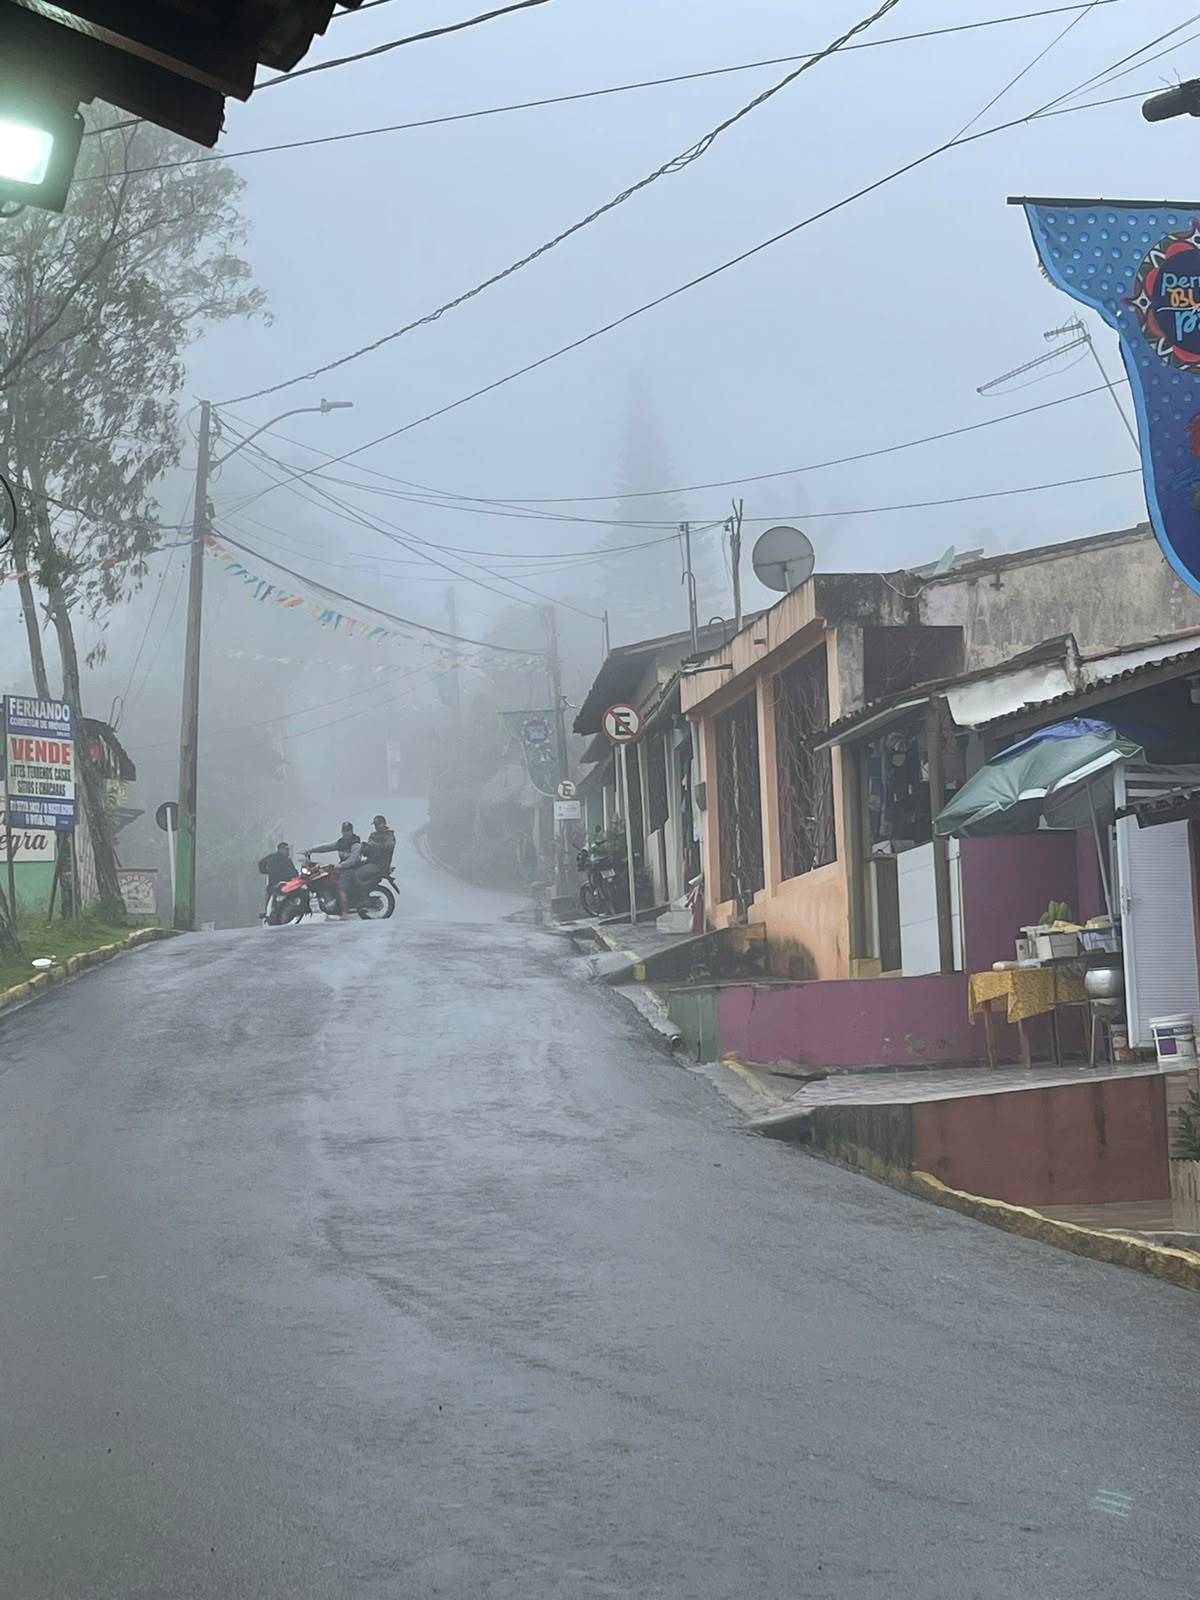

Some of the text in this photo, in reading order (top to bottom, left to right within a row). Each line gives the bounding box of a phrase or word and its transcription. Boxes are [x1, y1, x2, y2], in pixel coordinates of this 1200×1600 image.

[9, 697, 70, 722] FERNANDO
[615, 713, 630, 735] E
[11, 737, 71, 765] VENDE
